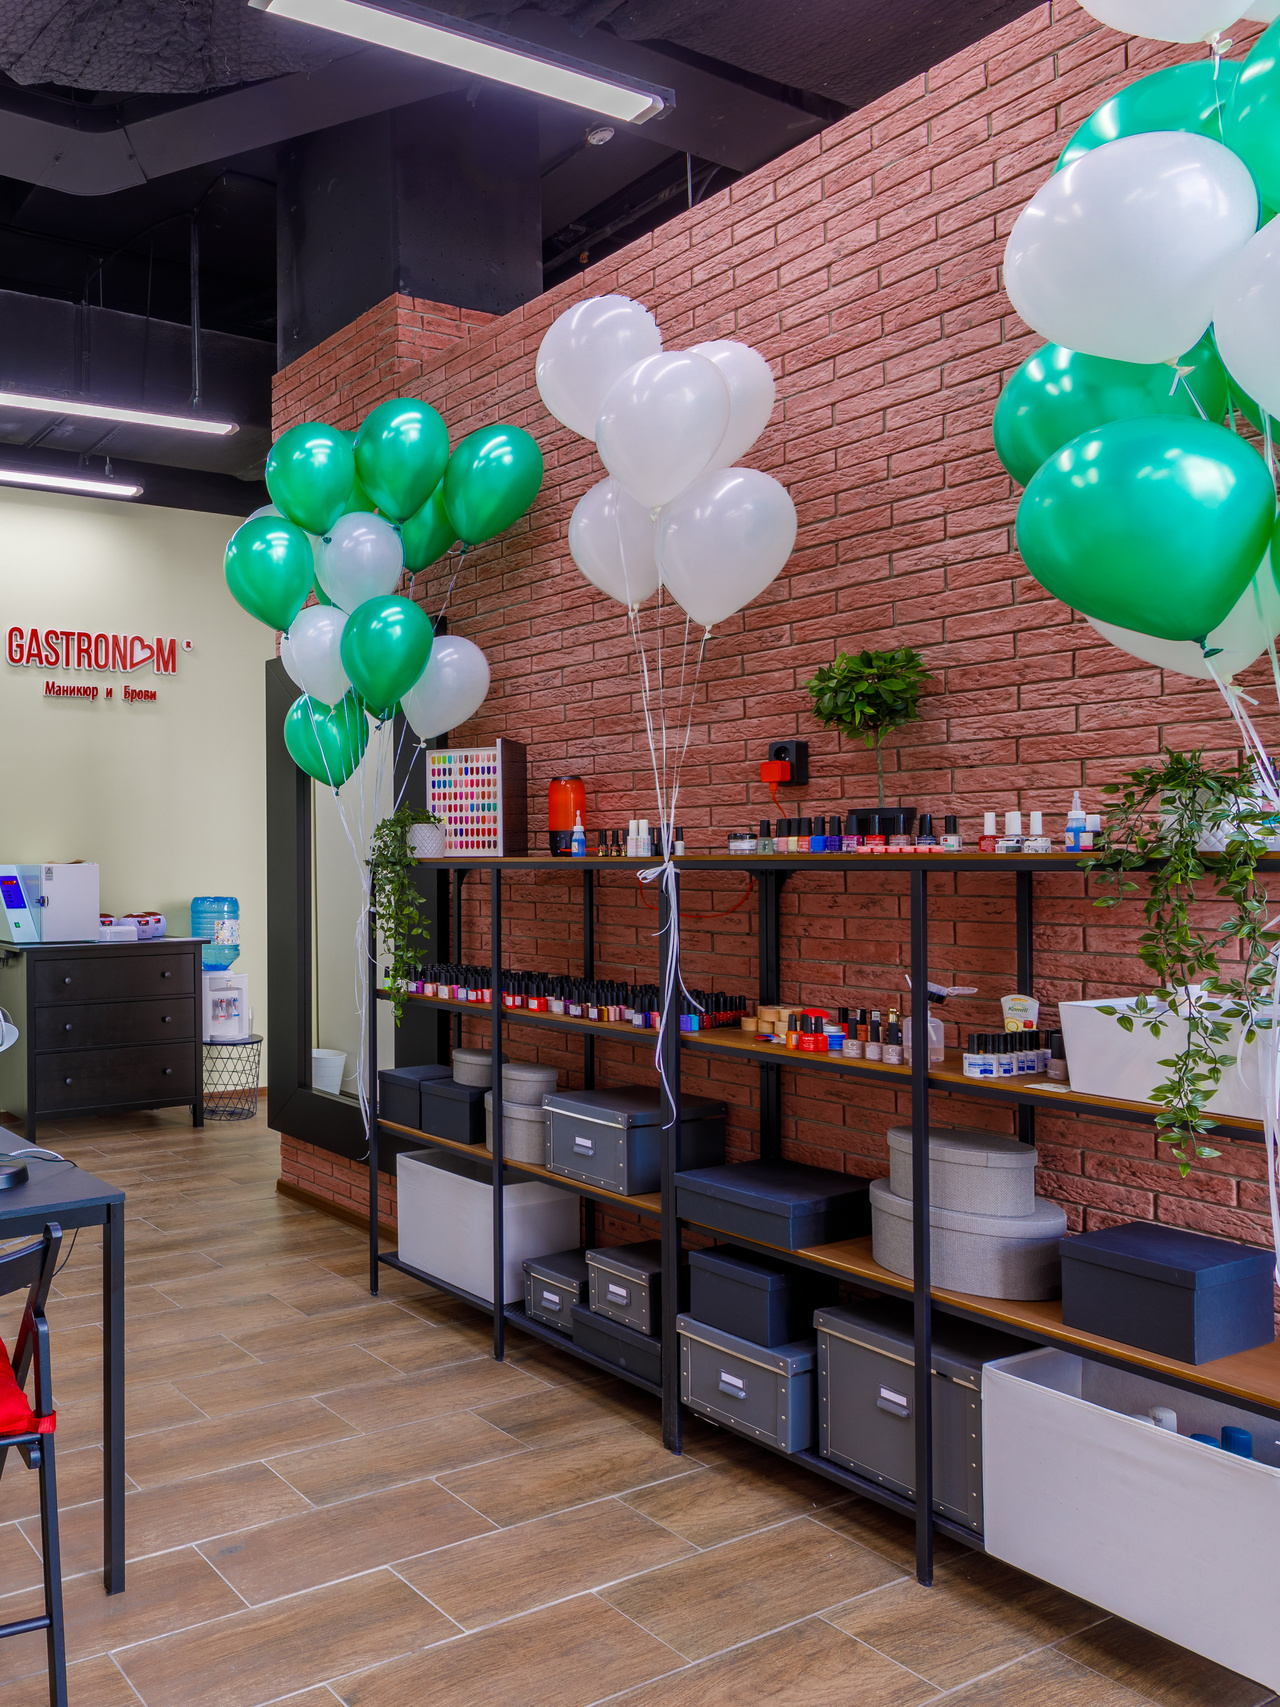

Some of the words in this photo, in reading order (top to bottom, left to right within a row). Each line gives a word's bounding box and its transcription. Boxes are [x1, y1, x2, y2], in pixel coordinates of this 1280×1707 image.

[44, 681, 99, 700] Маникюр
[105, 687, 113, 698] и
[123, 685, 157, 703] Брови
